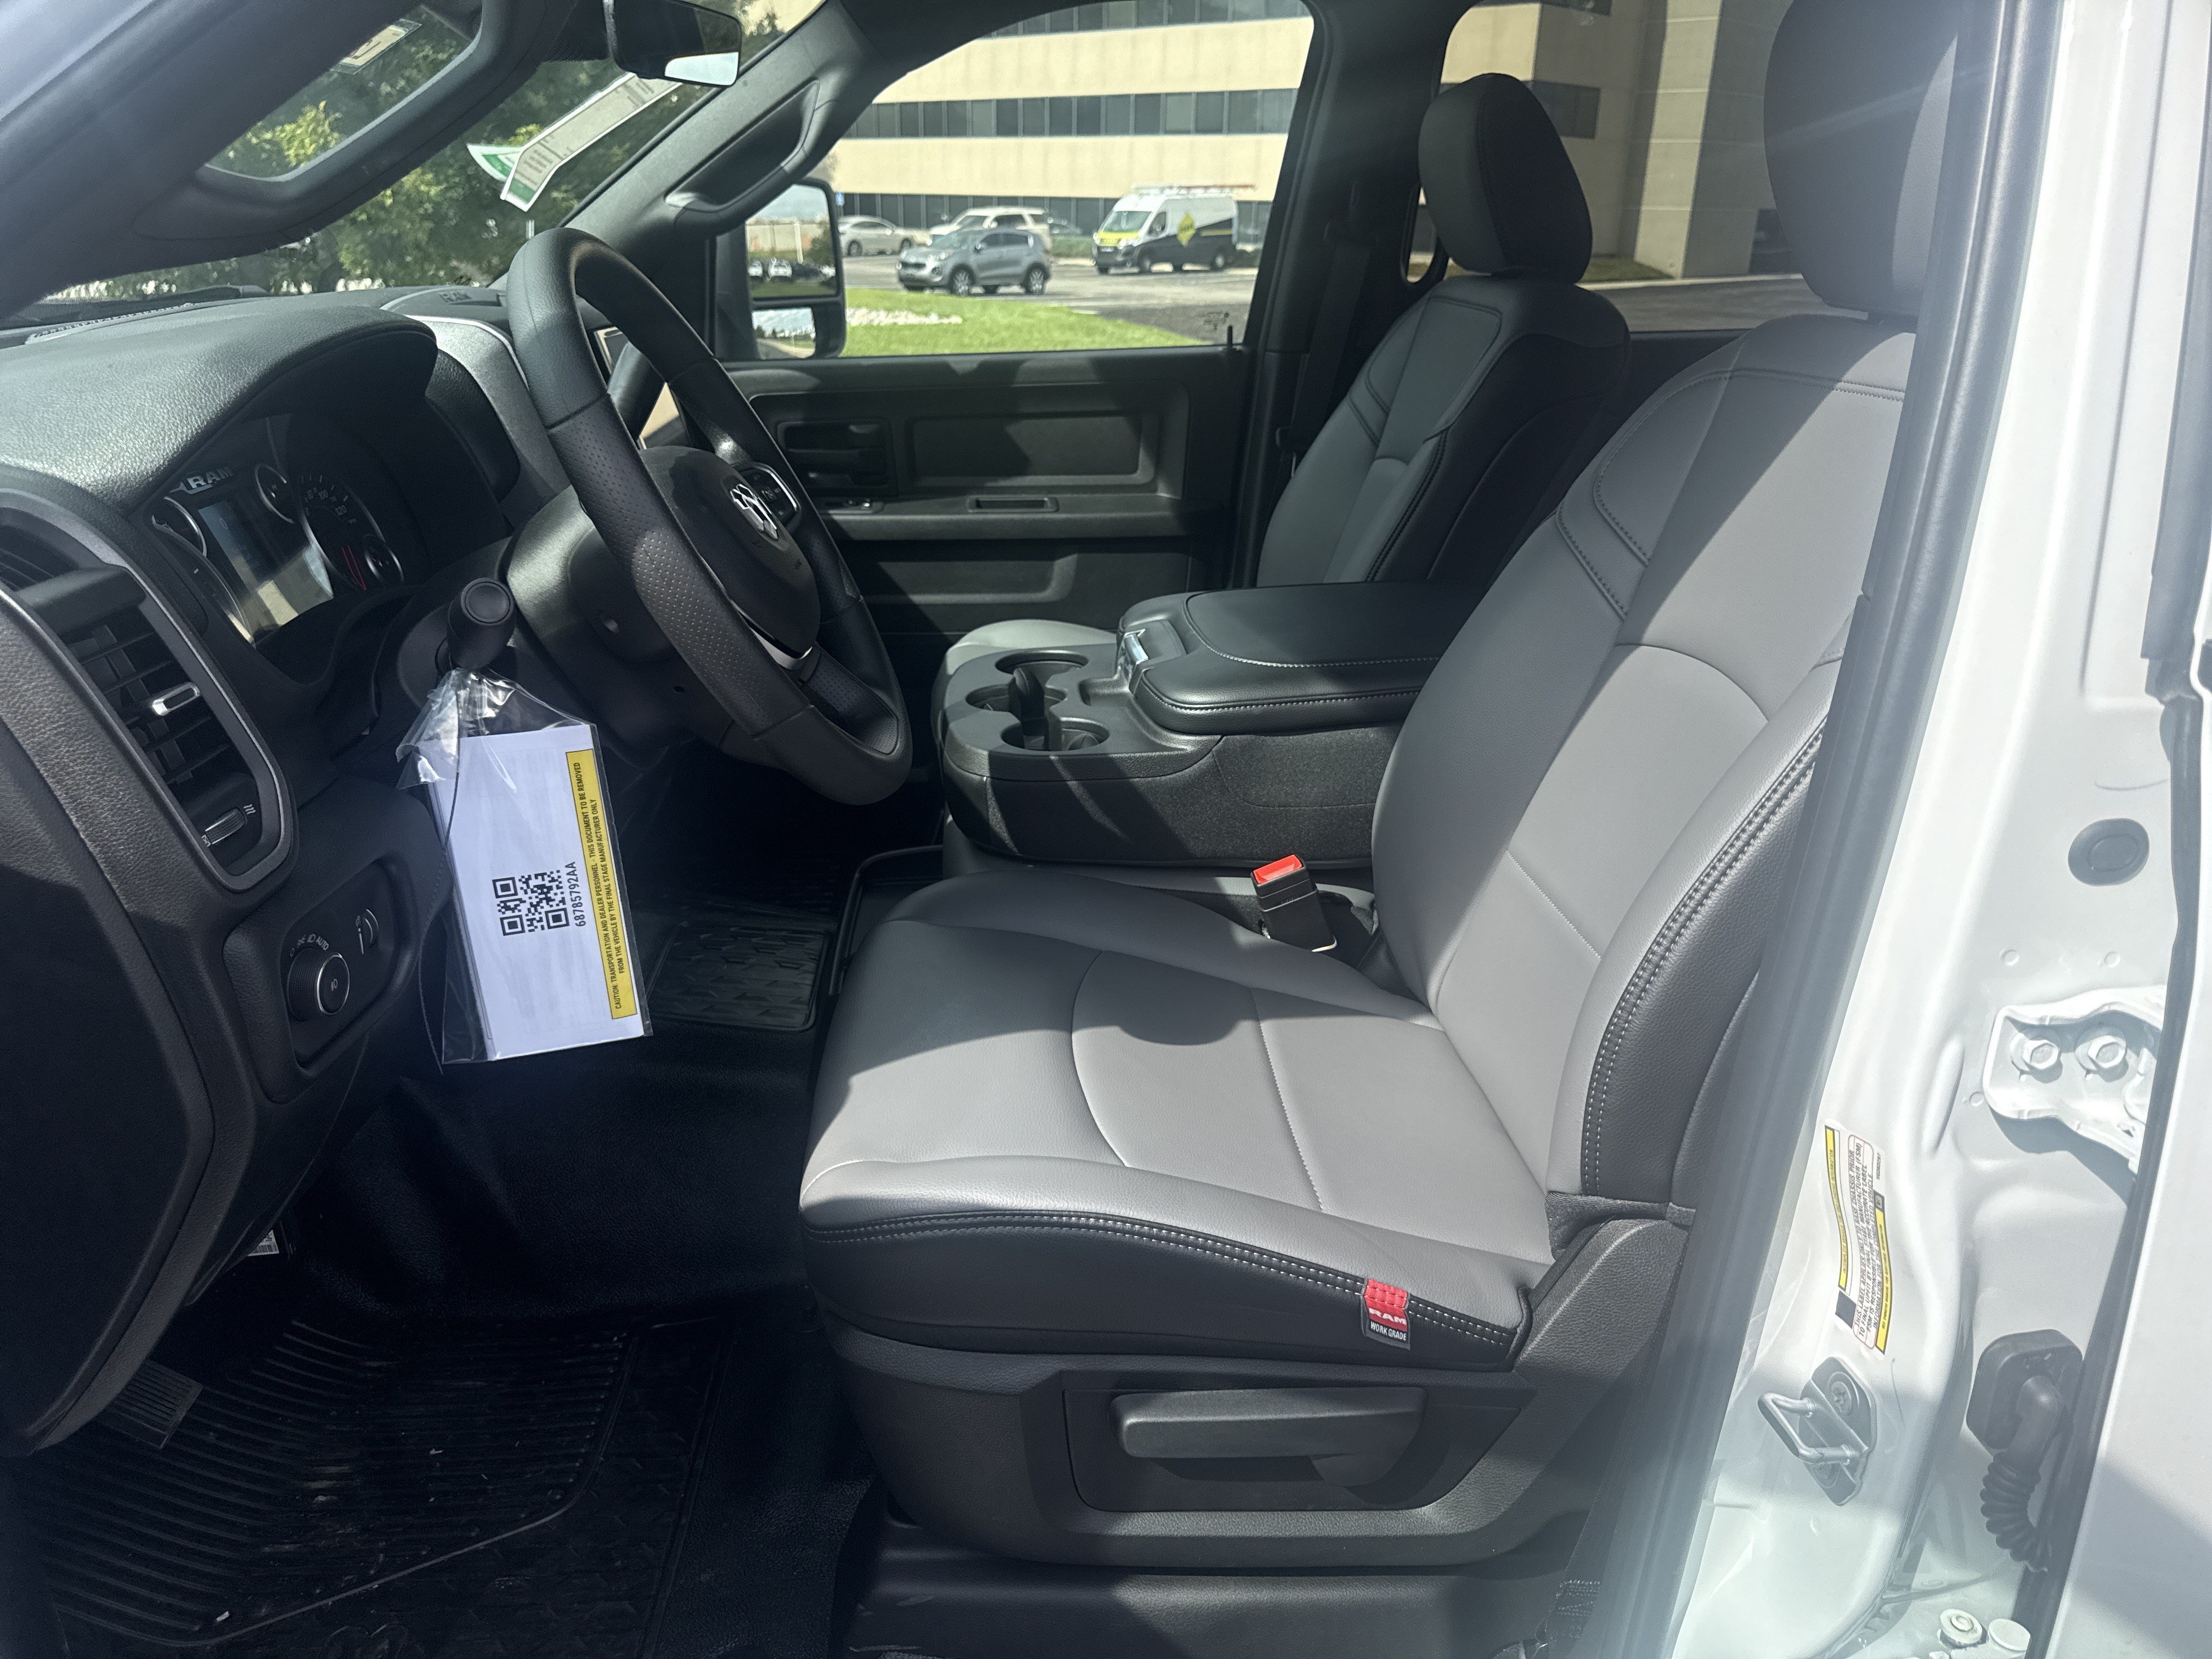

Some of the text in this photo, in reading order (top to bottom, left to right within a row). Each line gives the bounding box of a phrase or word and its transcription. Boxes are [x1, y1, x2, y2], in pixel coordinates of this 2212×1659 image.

[187, 466, 234, 488] RAM
[574, 763, 584, 791] REMOVED
[579, 792, 586, 800] BE
[580, 801, 588, 810] TO
[590, 799, 598, 814] ONLY
[582, 811, 594, 843] DOCUMENT
[593, 815, 606, 863] MANUFACTURER
[591, 862, 602, 896] PERSONNEL
[601, 864, 610, 882] STAGE
[565, 861, 586, 927] 68785792AA
[605, 883, 613, 900] FINAL
[597, 897, 606, 919] DEALER
[316, 936, 329, 950] AUTO
[611, 921, 620, 945] VEHICLE
[603, 933, 617, 983] TRANSPORTATION
[1855, 1165, 1865, 1224] MANUFACTURER
[1862, 1187, 1870, 1226] ACCURATE
[1855, 1224, 1862, 1234] TO
[1861, 1225, 1869, 1248] STAGE
[1869, 1205, 1879, 1247] COMPLETED
[1866, 1269, 1871, 1281] BY
[1869, 1306, 1874, 1315] IS
[1872, 1279, 1882, 1329] INFORMATION
[1369, 1308, 1407, 1325] RAM
[1370, 1321, 1407, 1341] WORK GRADE
[1859, 1327, 1865, 1337] TO
